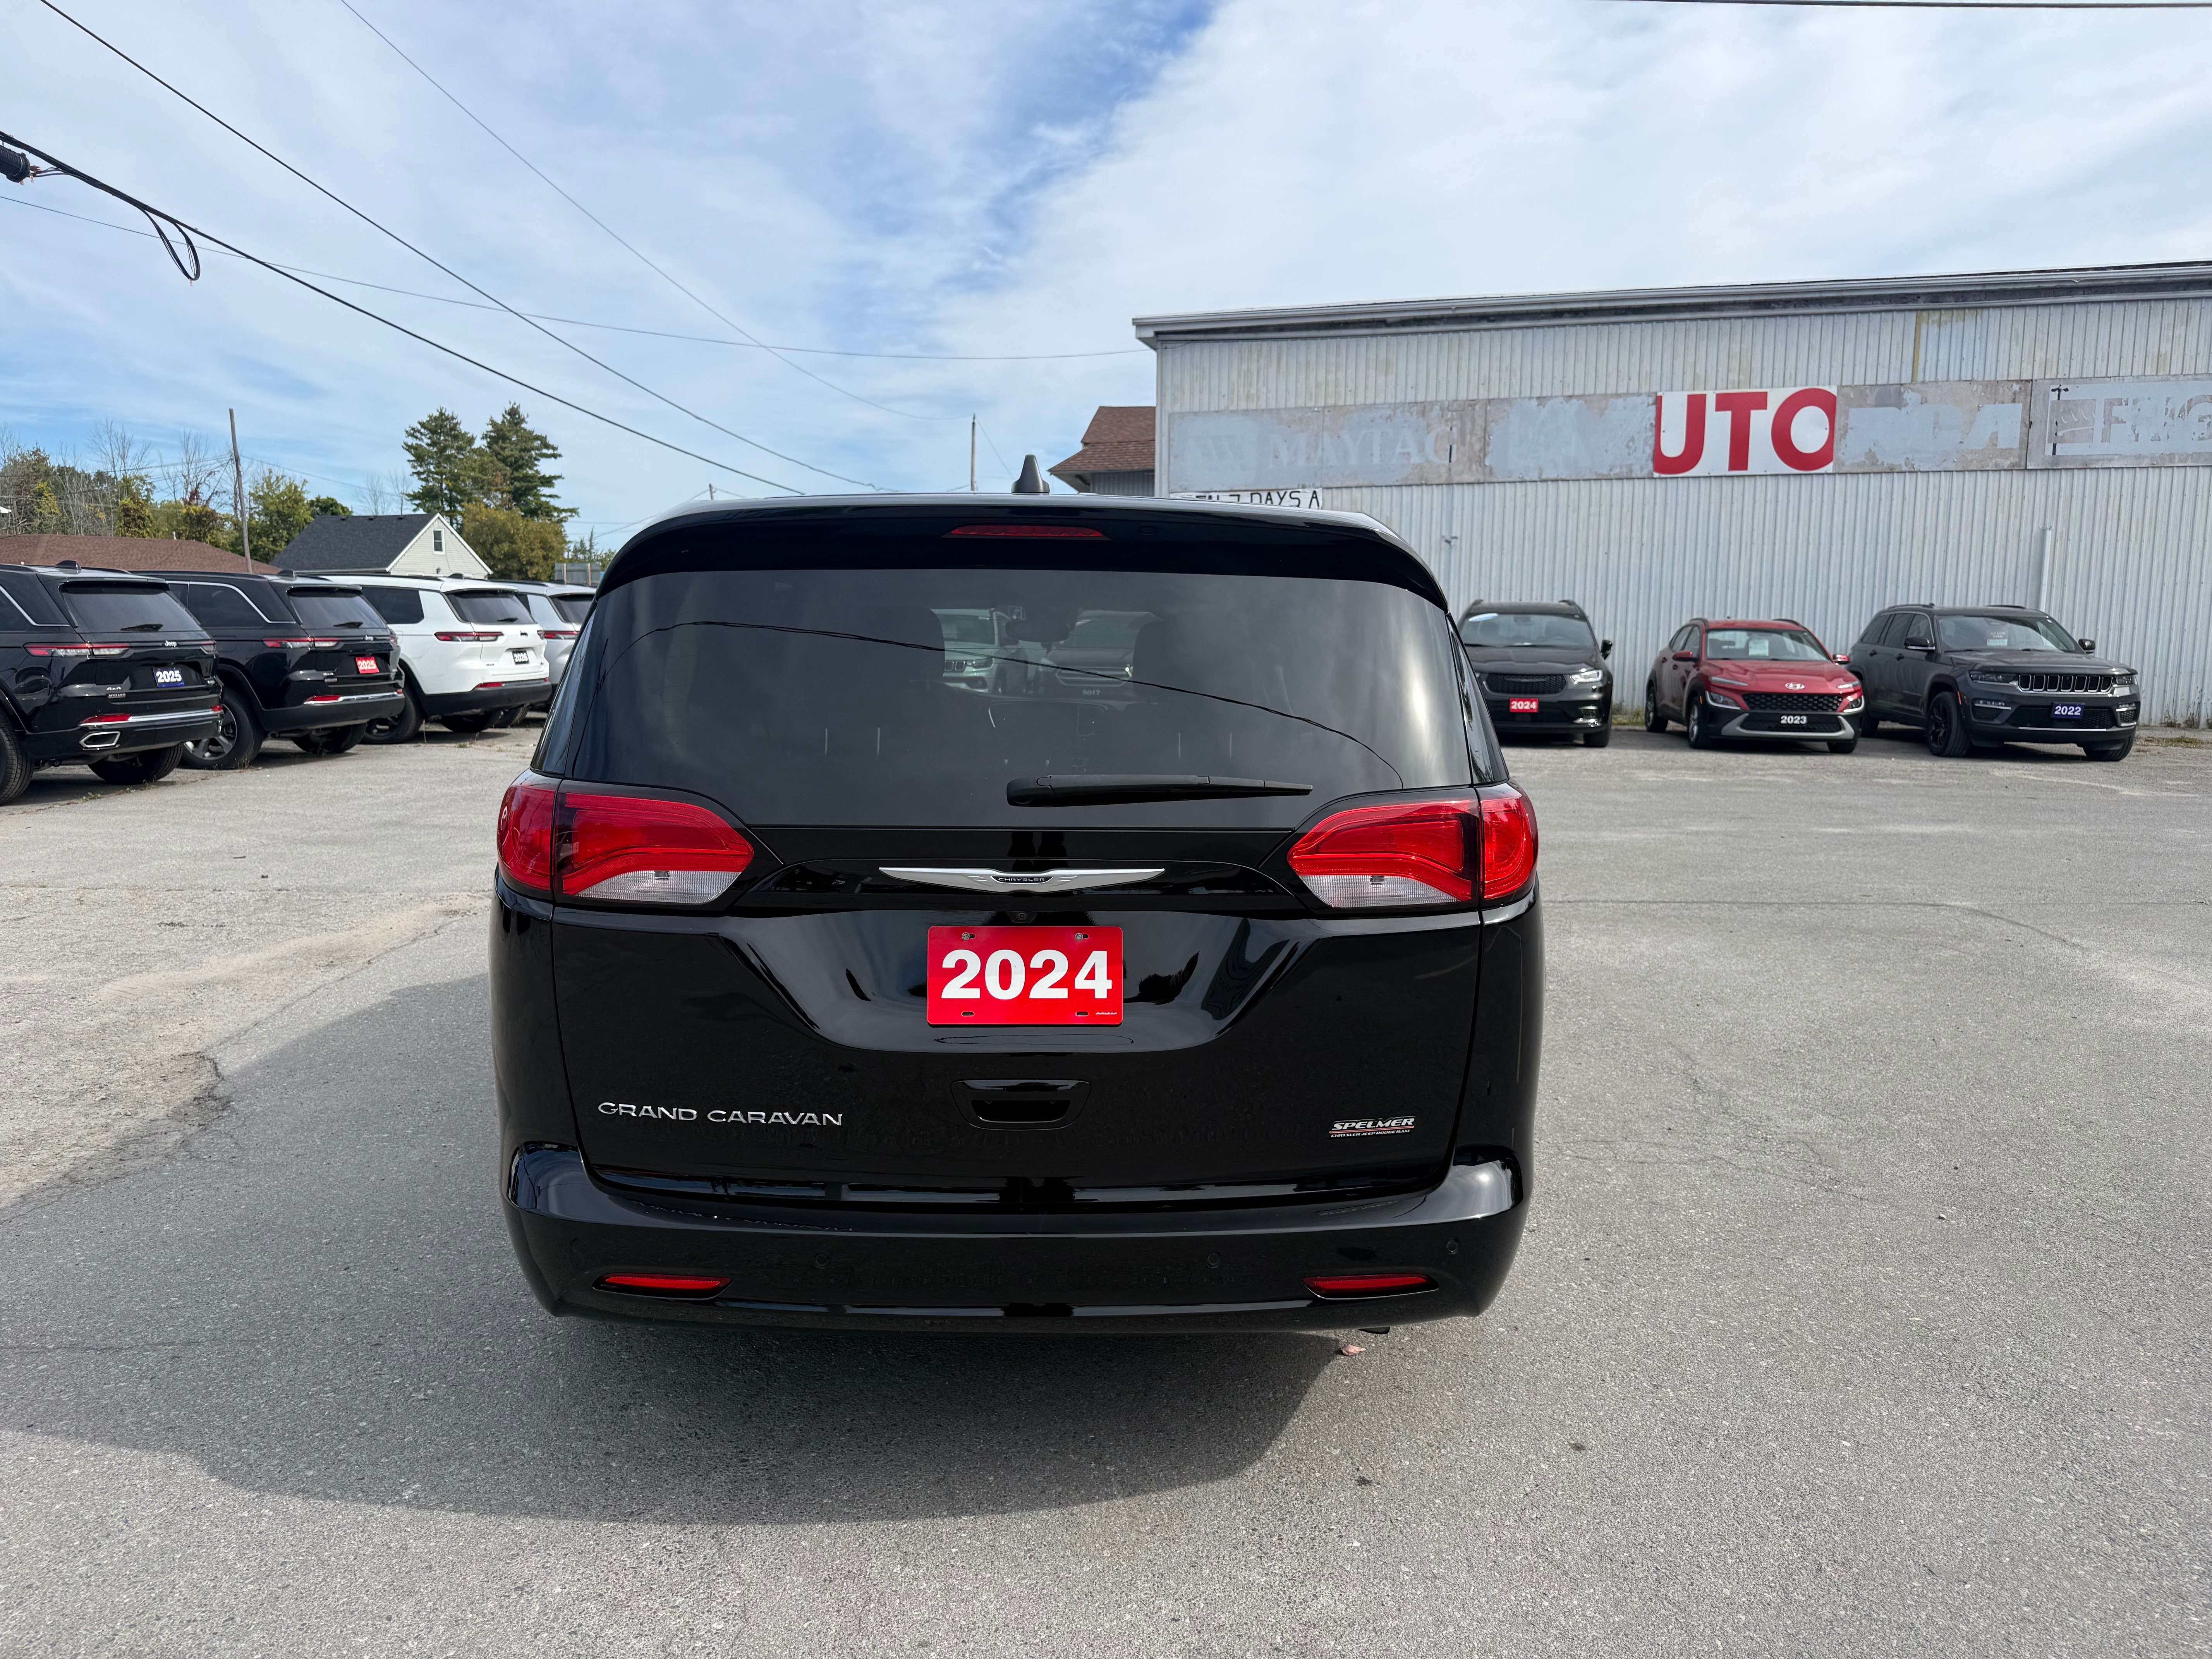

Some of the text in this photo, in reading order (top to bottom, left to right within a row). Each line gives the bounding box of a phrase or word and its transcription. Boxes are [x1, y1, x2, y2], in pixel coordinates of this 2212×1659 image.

[1653, 388, 1837, 475] UTO
[1309, 490, 1320, 509] A
[358, 660, 376, 670] 2025
[156, 670, 182, 683] 2025
[1511, 701, 1537, 710] 2024
[2054, 706, 2081, 715] 2022
[1780, 715, 1807, 724] 2023
[941, 949, 1113, 1000] 2024
[598, 1102, 843, 1126] GRAND CARAVAN
[1331, 1118, 1415, 1130] SPELMER
